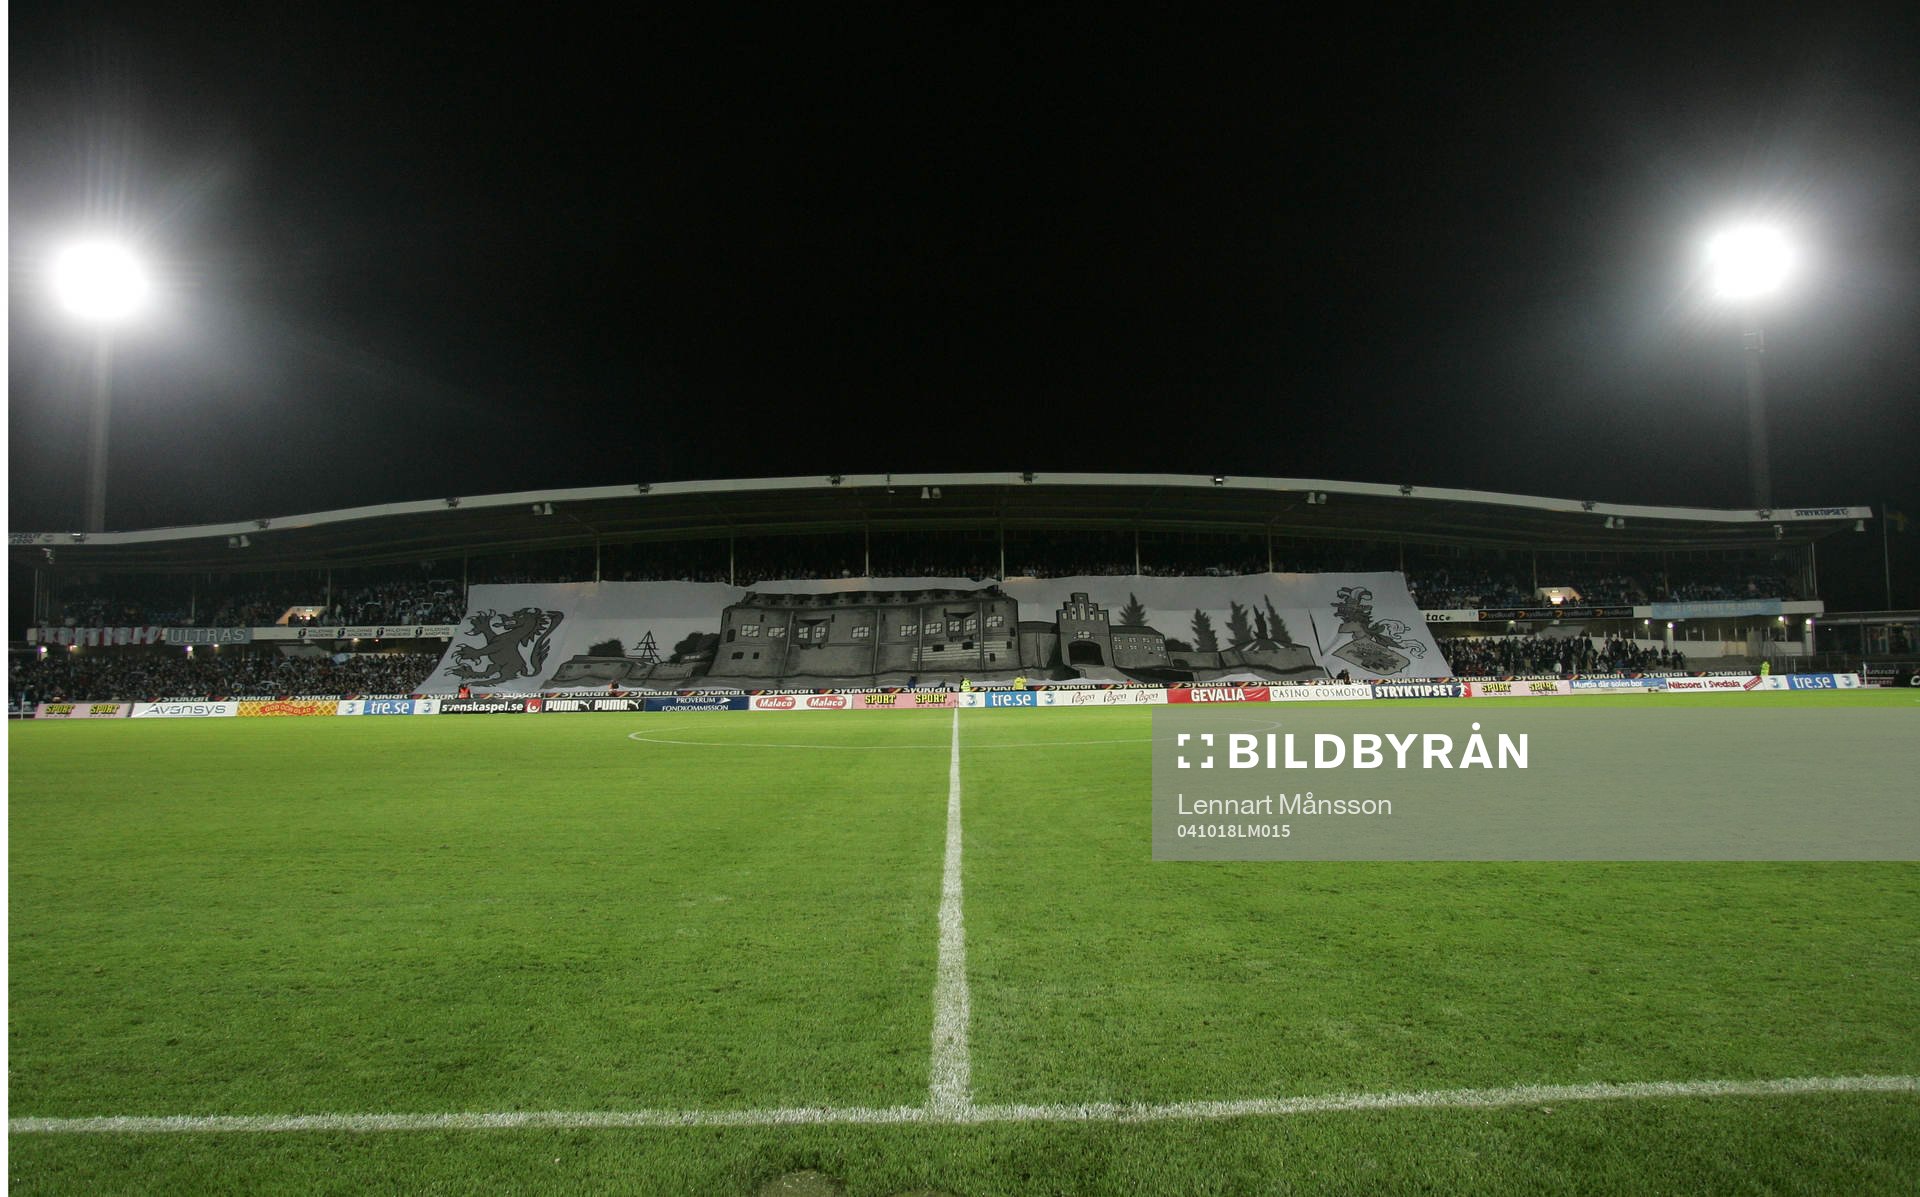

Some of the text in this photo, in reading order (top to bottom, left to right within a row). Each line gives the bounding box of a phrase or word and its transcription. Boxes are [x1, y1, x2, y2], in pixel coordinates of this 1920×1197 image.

[170, 629, 245, 643] ULTRAS
[1482, 682, 1512, 692] SPORT
[1529, 681, 1558, 691] SPORT
[1668, 680, 1702, 689] Nilssons
[1708, 680, 1741, 688] Svedala
[1792, 675, 1831, 689] tre.se
[1191, 688, 1245, 702] GEVALIA
[1272, 687, 1370, 698] CASINO COSMOPOL
[1376, 684, 1453, 698] STRYKTIPSET
[758, 697, 794, 708] Malaco
[810, 696, 843, 707] Malaco
[865, 694, 896, 704] SPORT
[915, 694, 947, 703] SPORT
[992, 692, 1031, 706] tre.se
[46, 705, 76, 714] SPORT
[90, 705, 120, 714] SPORT
[371, 700, 410, 714] tre.se
[441, 701, 523, 712] svenskaspel.se
